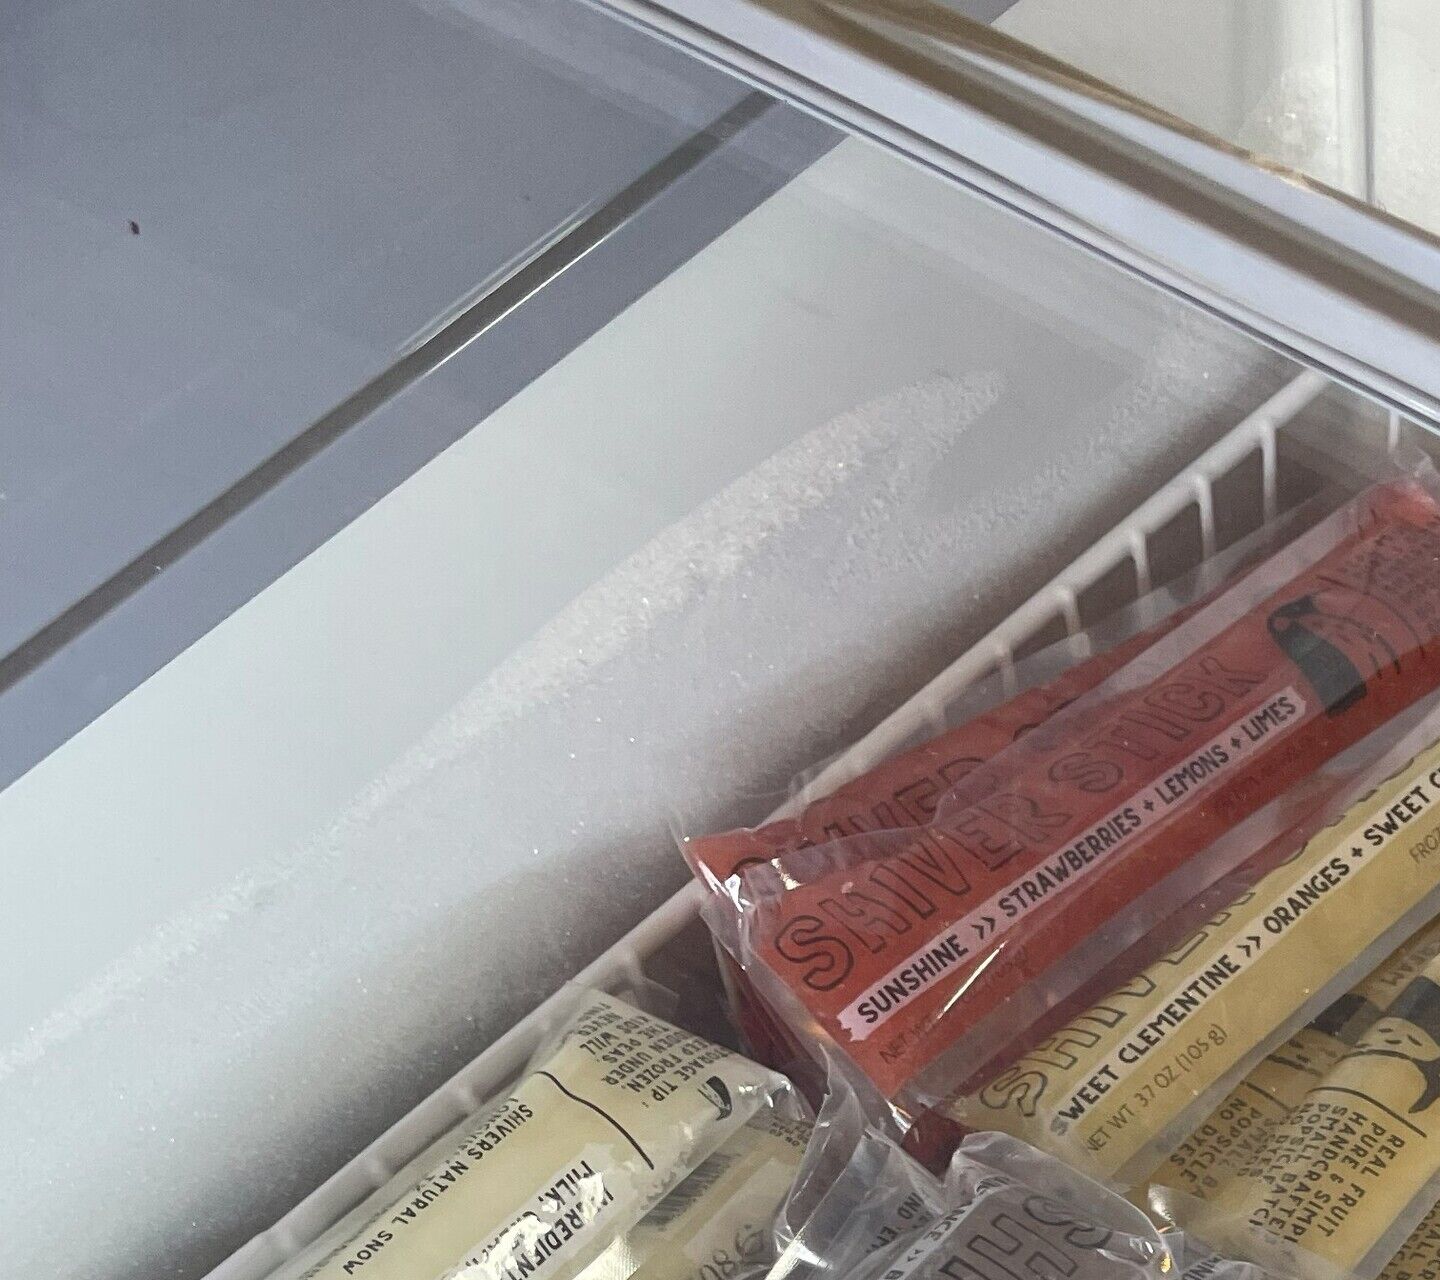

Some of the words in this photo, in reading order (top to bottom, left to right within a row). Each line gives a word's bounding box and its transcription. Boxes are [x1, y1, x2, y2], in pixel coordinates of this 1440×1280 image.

[773, 759, 1068, 995] SHIVER
[1048, 635, 1267, 810] STICK
[855, 935, 970, 1024] SUNSHINE
[996, 806, 1143, 917] STRAWBERRIES
[1154, 743, 1231, 805] LEMONS
[1241, 694, 1298, 741] LIMES
[1042, 1058, 1126, 1138] SWEET
[1112, 951, 1241, 1070] CLEMENTINE
[1261, 853, 1353, 939] ORANGES
[1362, 784, 1433, 851] SWEET
[601, 1045, 653, 1091] UNDER
[1150, 1061, 1181, 1092] OZ
[466, 1104, 534, 1160] SHIVERS
[1360, 1132, 1403, 1180] REAL
[388, 1160, 470, 1228] NATURAL
[1316, 1181, 1364, 1237] FRUIT
[340, 1229, 394, 1273] SNOW
